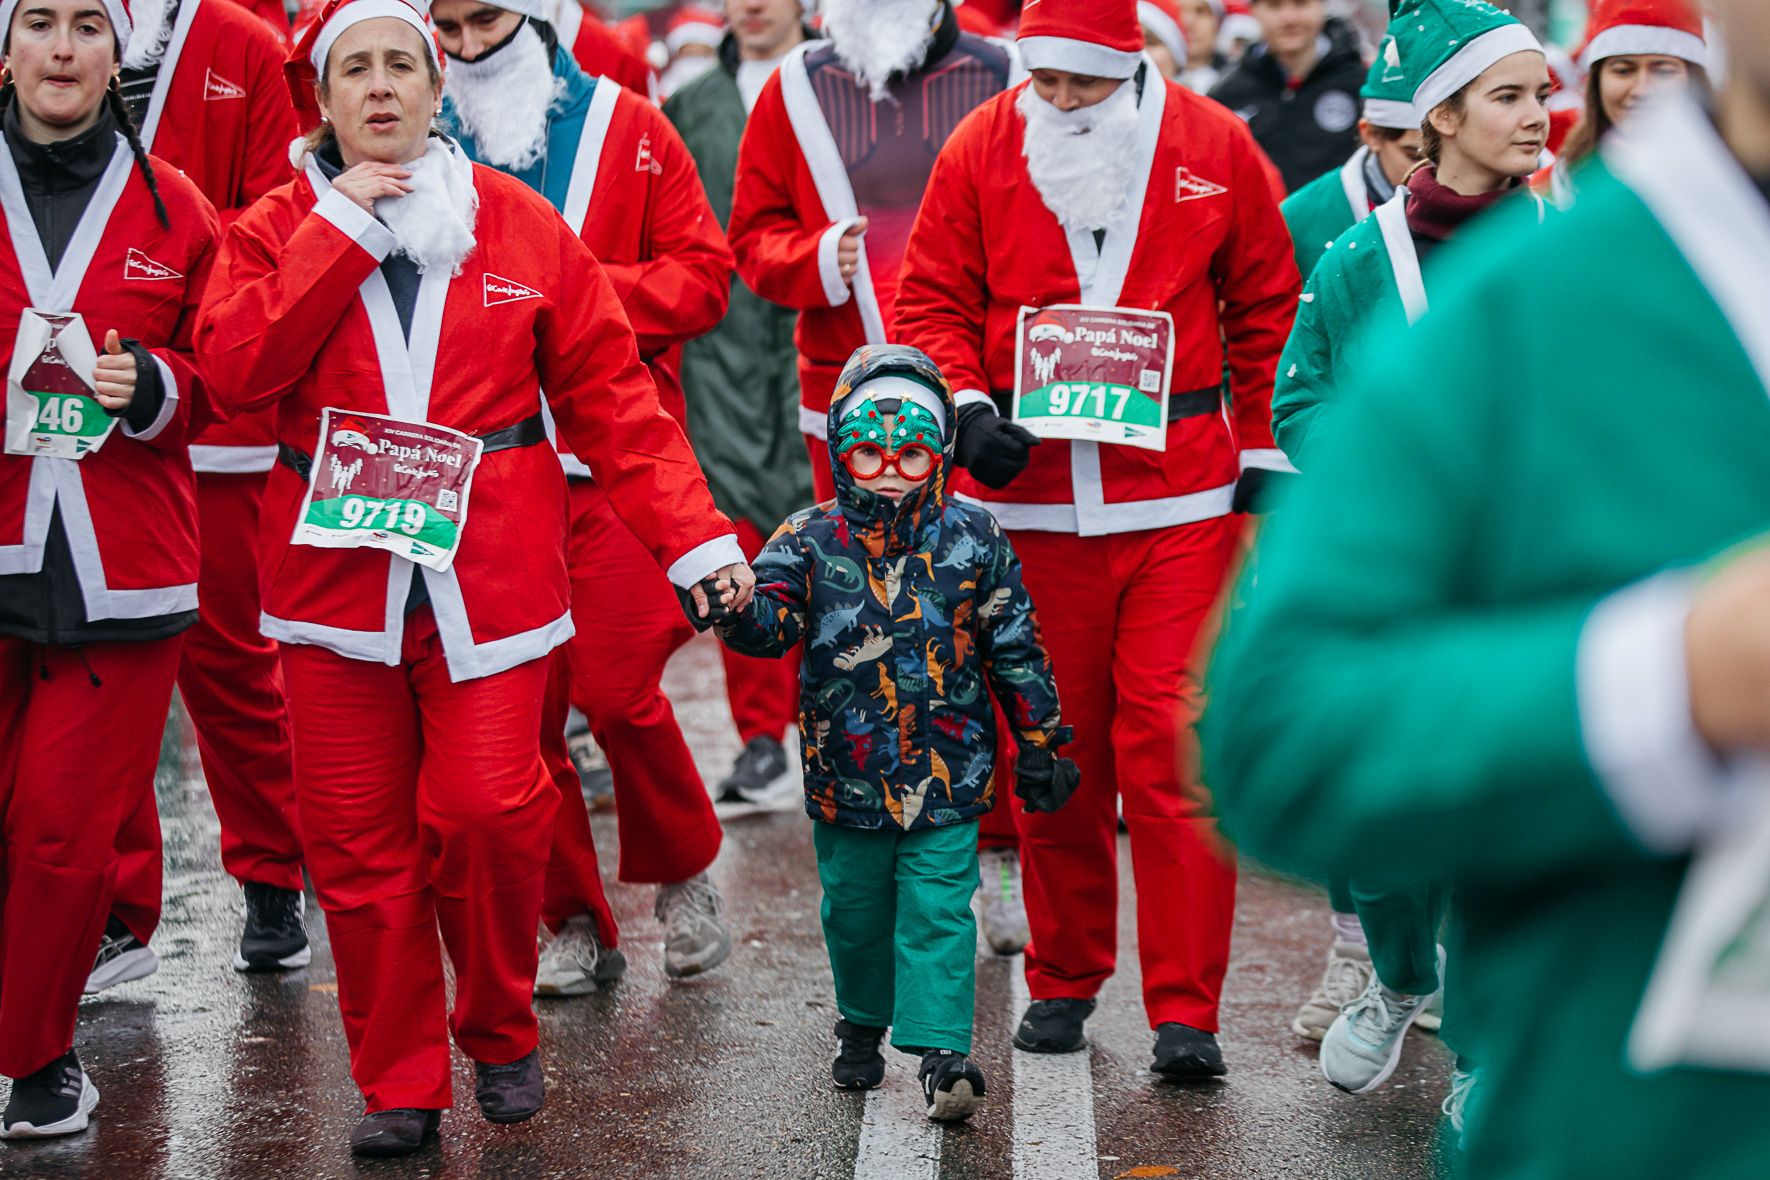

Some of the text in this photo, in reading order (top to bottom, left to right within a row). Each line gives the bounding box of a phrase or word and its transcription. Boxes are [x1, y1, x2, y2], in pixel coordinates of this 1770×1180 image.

[1075, 326, 1158, 349] Papá Noel
[33, 397, 84, 433] 46
[1048, 384, 1132, 420] 9717
[378, 438, 463, 468] Papá Noel
[339, 498, 426, 535] 9719
